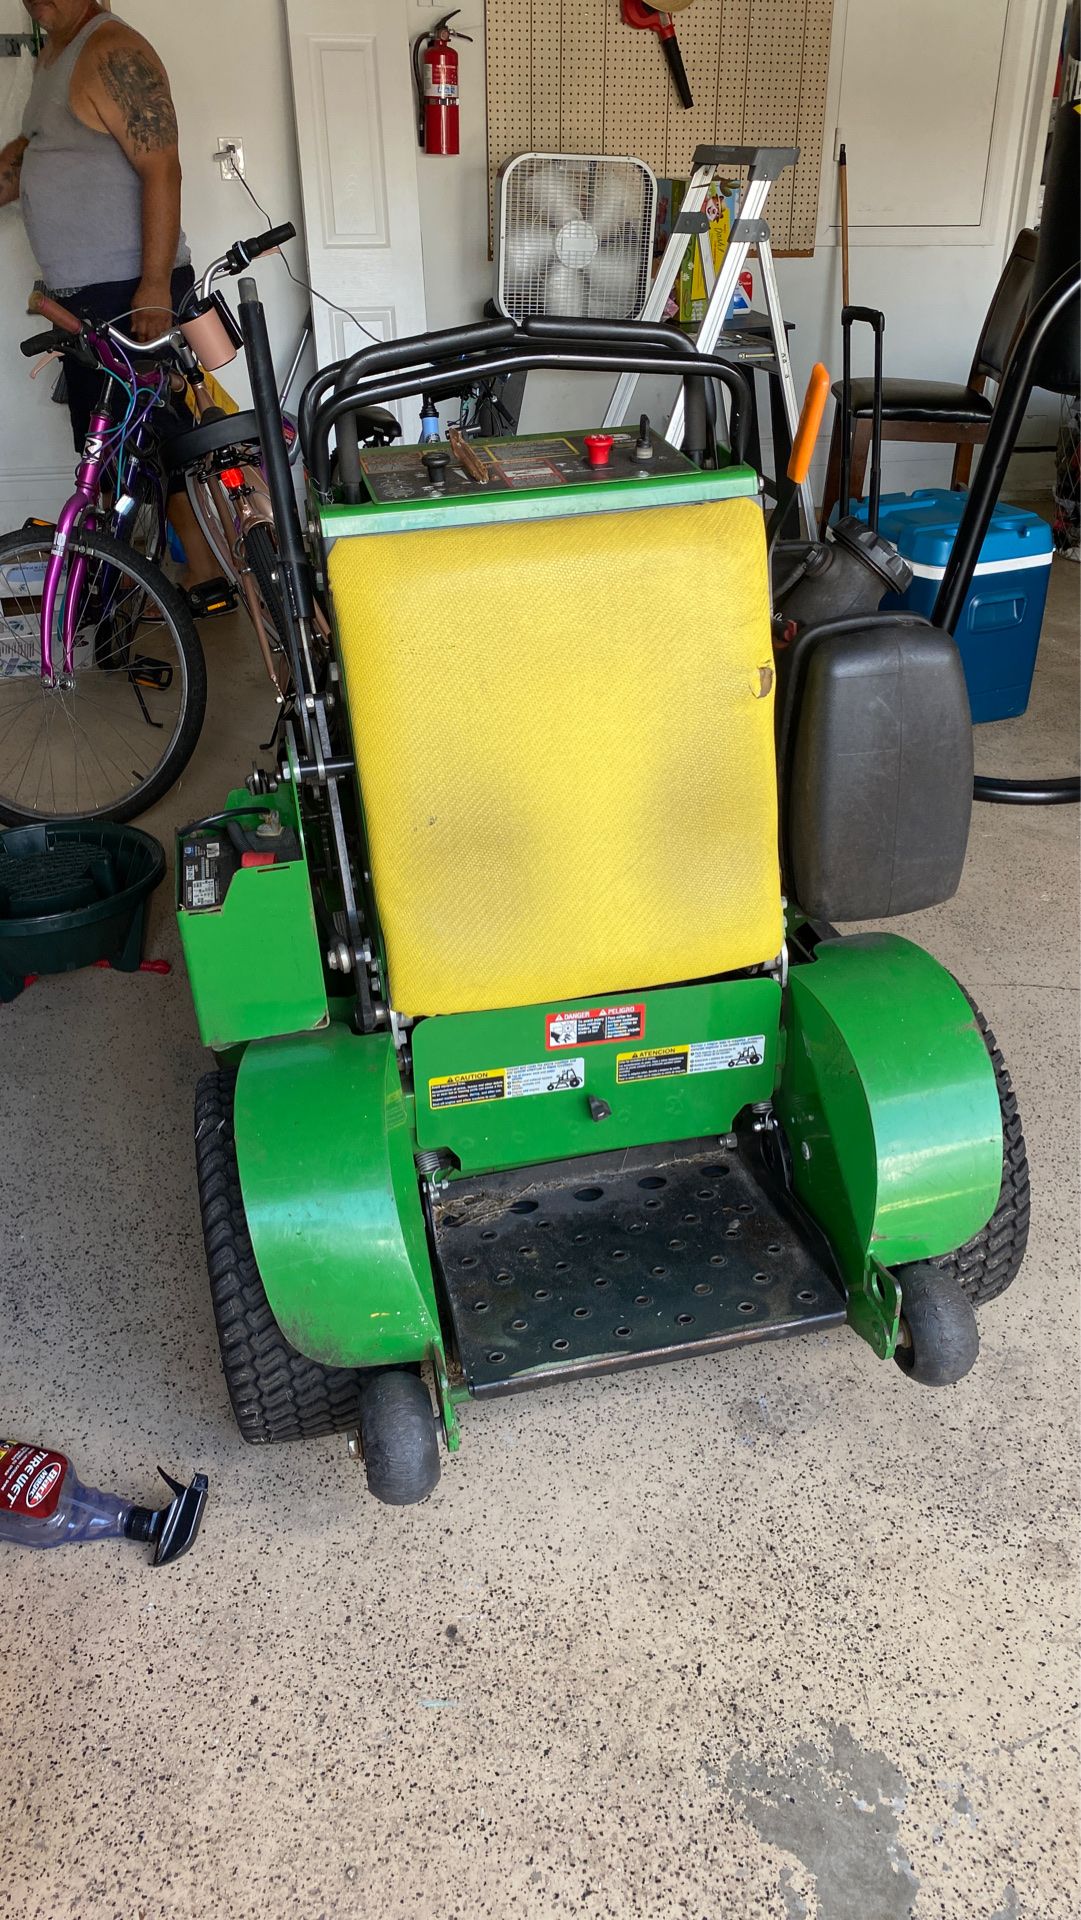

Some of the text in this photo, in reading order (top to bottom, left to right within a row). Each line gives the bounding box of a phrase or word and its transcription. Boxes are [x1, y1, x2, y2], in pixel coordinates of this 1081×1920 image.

[608, 1006, 635, 1015] PELIGRO
[564, 1011, 590, 1020] DANGER
[454, 1072, 489, 1082] CAUTION
[34, 1468, 58, 1502] Black
